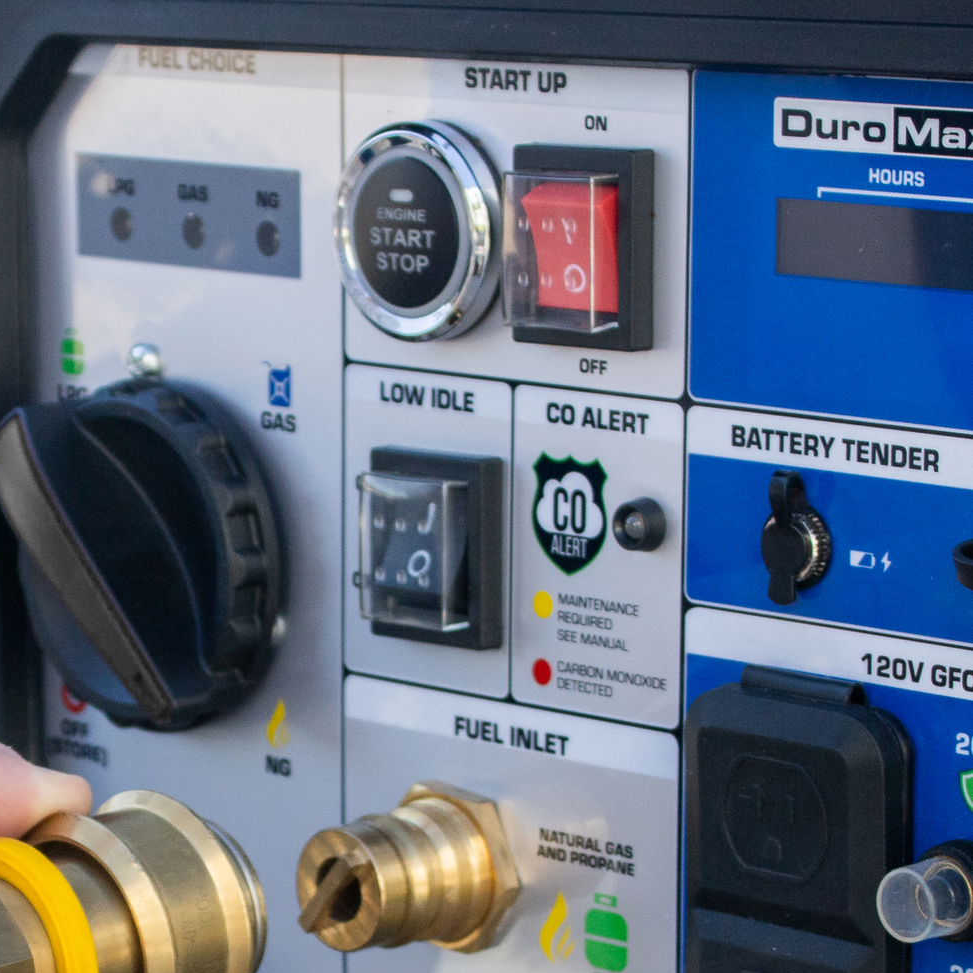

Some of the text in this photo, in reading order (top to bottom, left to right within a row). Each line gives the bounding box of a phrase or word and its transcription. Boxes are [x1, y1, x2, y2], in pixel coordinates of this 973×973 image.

[137, 46, 256, 75] FUEL CHOICE
[465, 67, 567, 93] START UP
[584, 115, 608, 131] ON
[782, 108, 973, 150] DuroMa
[869, 167, 925, 187] HOURS
[177, 184, 208, 202] GAS
[256, 190, 279, 208] NG
[377, 207, 426, 222] ENGINE
[369, 227, 435, 249] START
[376, 252, 430, 273] STOP
[579, 358, 608, 375] OFF
[380, 381, 474, 413] LOW IDLE
[260, 411, 296, 432] GAS
[546, 402, 649, 435] CO ALERT
[731, 424, 939, 472] BATTERY TENDER
[553, 486, 587, 534] CO
[551, 534, 588, 559] ALERT
[558, 593, 639, 617] MAINTENANCE
[557, 610, 613, 630] REQUIRED
[557, 629, 628, 652] SEE MANUAL
[557, 660, 667, 691] CARBON MONOXIDE
[861, 653, 924, 683] 120V
[557, 677, 613, 697] DETECTED
[455, 715, 569, 756] FUEL INLET
[265, 755, 291, 777] NG
[539, 827, 633, 859] NATURAL GAS
[537, 844, 635, 877] AND PROPANE
